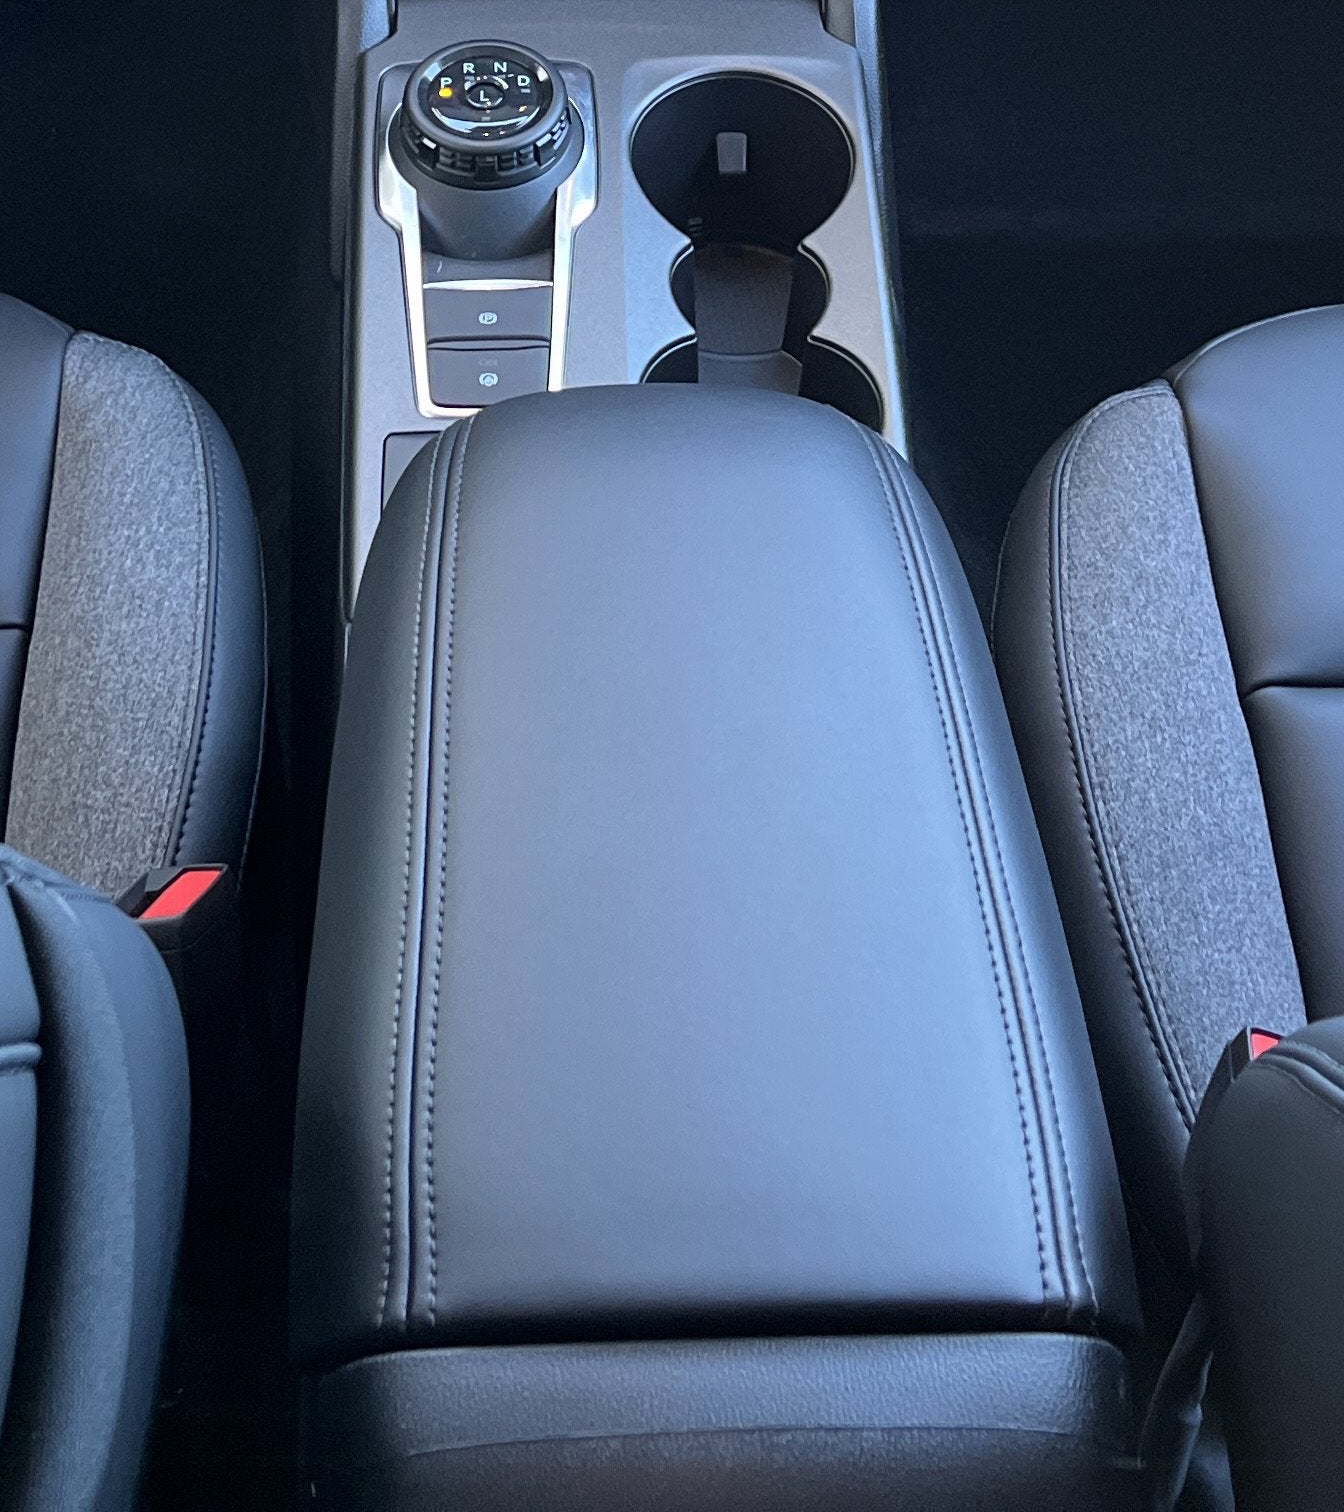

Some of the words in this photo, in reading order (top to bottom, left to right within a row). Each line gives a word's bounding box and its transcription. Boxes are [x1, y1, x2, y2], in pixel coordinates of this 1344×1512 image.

[463, 62, 475, 74] R
[494, 62, 507, 72] N
[441, 77, 452, 88] P
[518, 75, 530, 86] D
[480, 90, 489, 102] L
